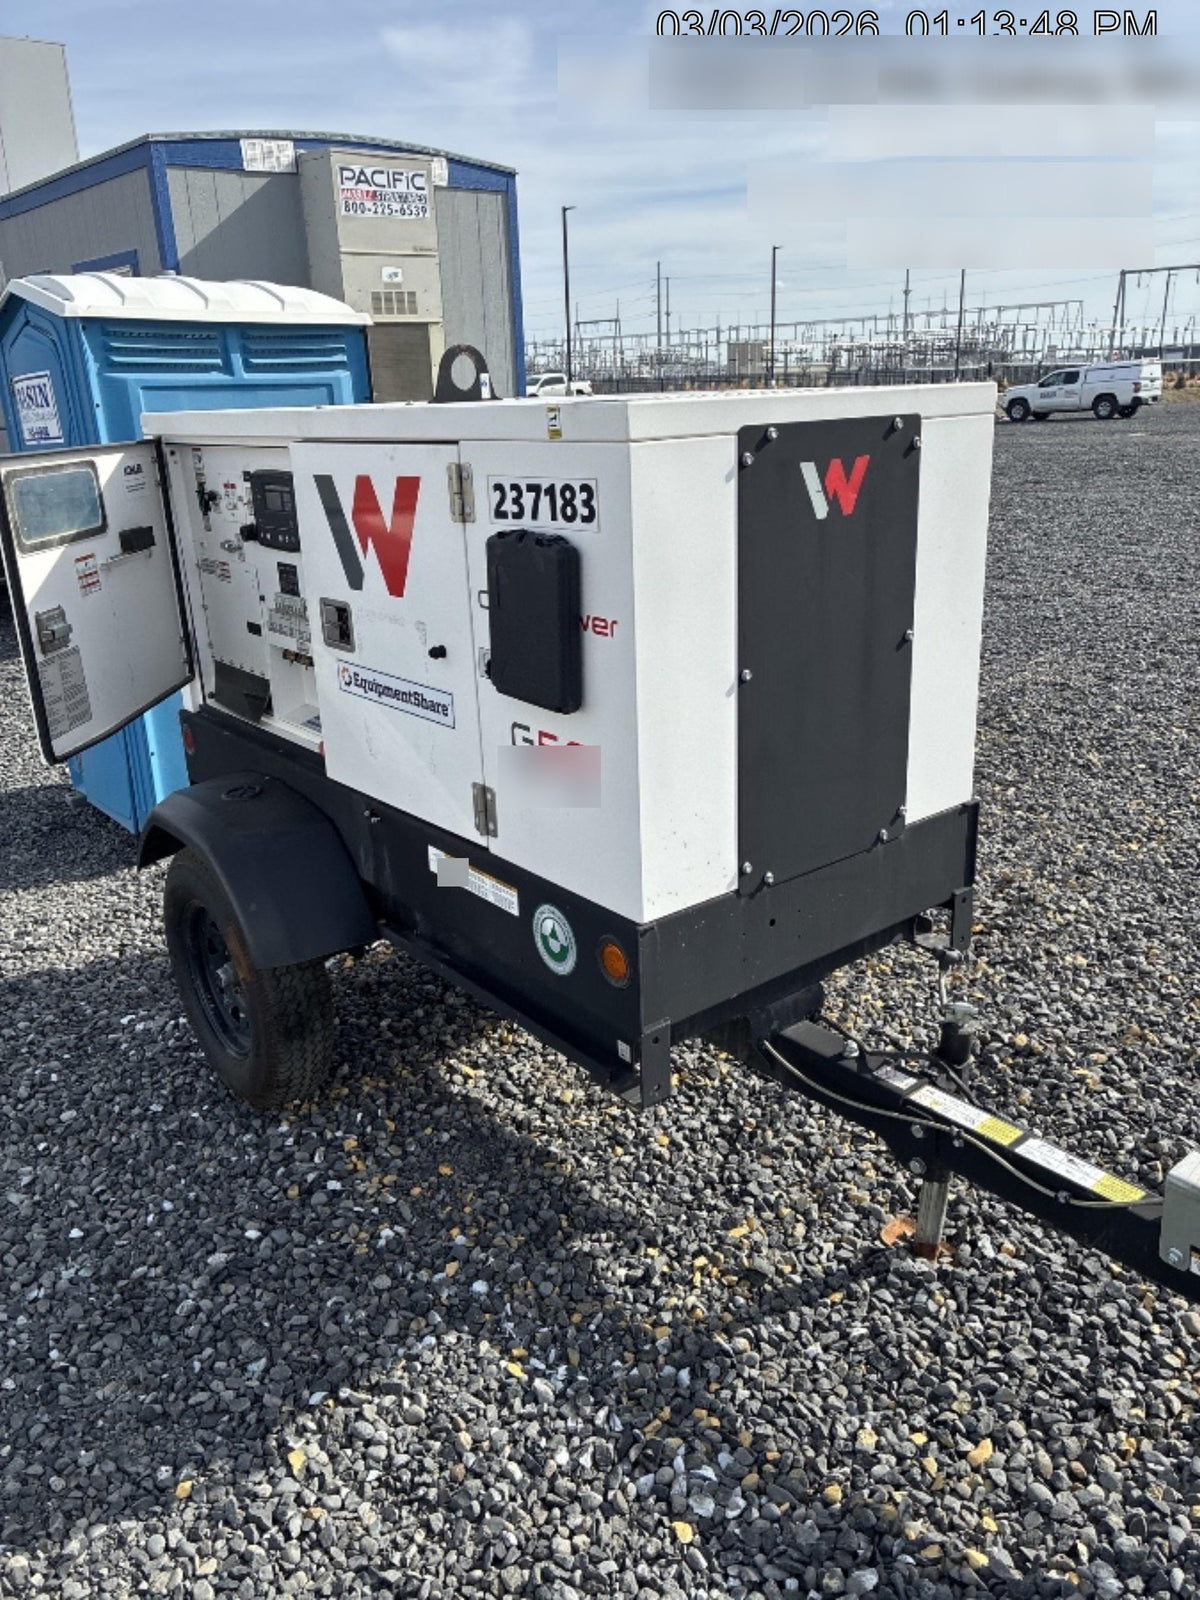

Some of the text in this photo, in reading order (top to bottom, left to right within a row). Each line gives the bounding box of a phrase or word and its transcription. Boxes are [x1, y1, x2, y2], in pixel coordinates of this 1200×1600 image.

[344, 200, 428, 217] 800-225-6539
[493, 483, 597, 523] 237183
[353, 671, 449, 717] EquipmentShare
